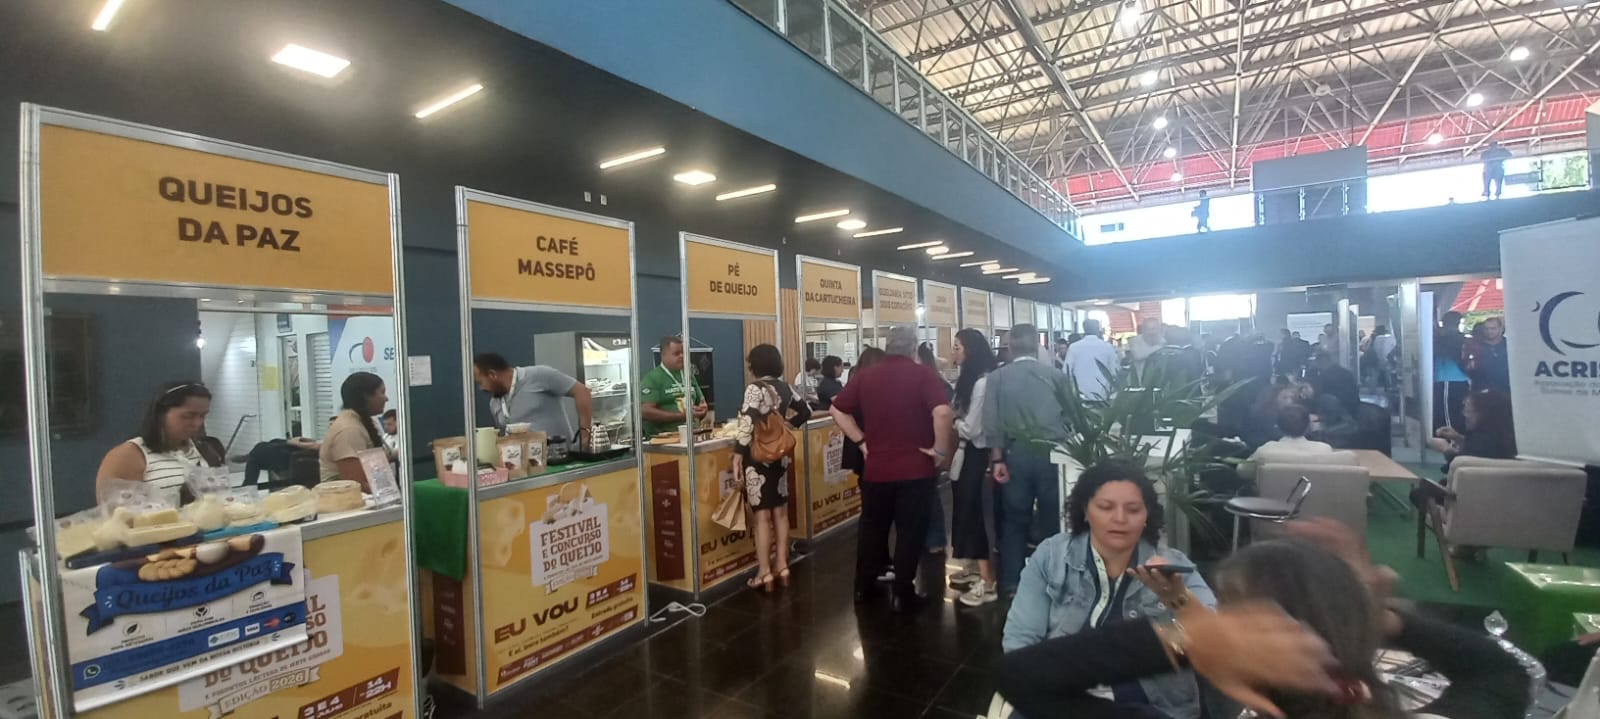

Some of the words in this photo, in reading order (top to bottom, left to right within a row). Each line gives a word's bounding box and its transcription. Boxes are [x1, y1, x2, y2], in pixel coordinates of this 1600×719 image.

[159, 176, 313, 218] QUEIJOS
[178, 217, 229, 245] DA
[236, 223, 301, 252] PAZ
[536, 235, 579, 256] CAFÉ
[518, 258, 596, 282] MASSEPÔ
[728, 262, 740, 277] PÉ
[710, 281, 723, 293] DE
[724, 281, 758, 297] QUEIJO
[820, 278, 842, 290] QUINTA
[805, 292, 814, 302] DA
[815, 292, 856, 305] CARTUCHEIRA
[1534, 360, 1600, 378] ACRI
[813, 499, 824, 511] EU
[825, 492, 841, 505] VOU
[541, 516, 601, 546] FESTIVAL
[701, 540, 717, 554] EU
[721, 529, 745, 547] VOU
[542, 548, 548, 559] E
[551, 529, 602, 555] CONCURSO
[543, 558, 557, 572] DO
[560, 542, 602, 567] QUEIJO
[116, 587, 199, 609] Queijos
[205, 575, 230, 594] da
[234, 561, 273, 585] Paz
[494, 617, 527, 644] EU
[532, 597, 578, 626] VOU
[591, 607, 613, 619] Entrada
[140, 670, 164, 681] SABOR
[166, 666, 180, 674] QUE
[182, 661, 197, 669] VEM
[225, 684, 268, 709] EDIÇÃO
[271, 672, 305, 689] 2026
[304, 706, 314, 716] 3
[317, 701, 327, 711] E
[330, 695, 341, 706] 4
